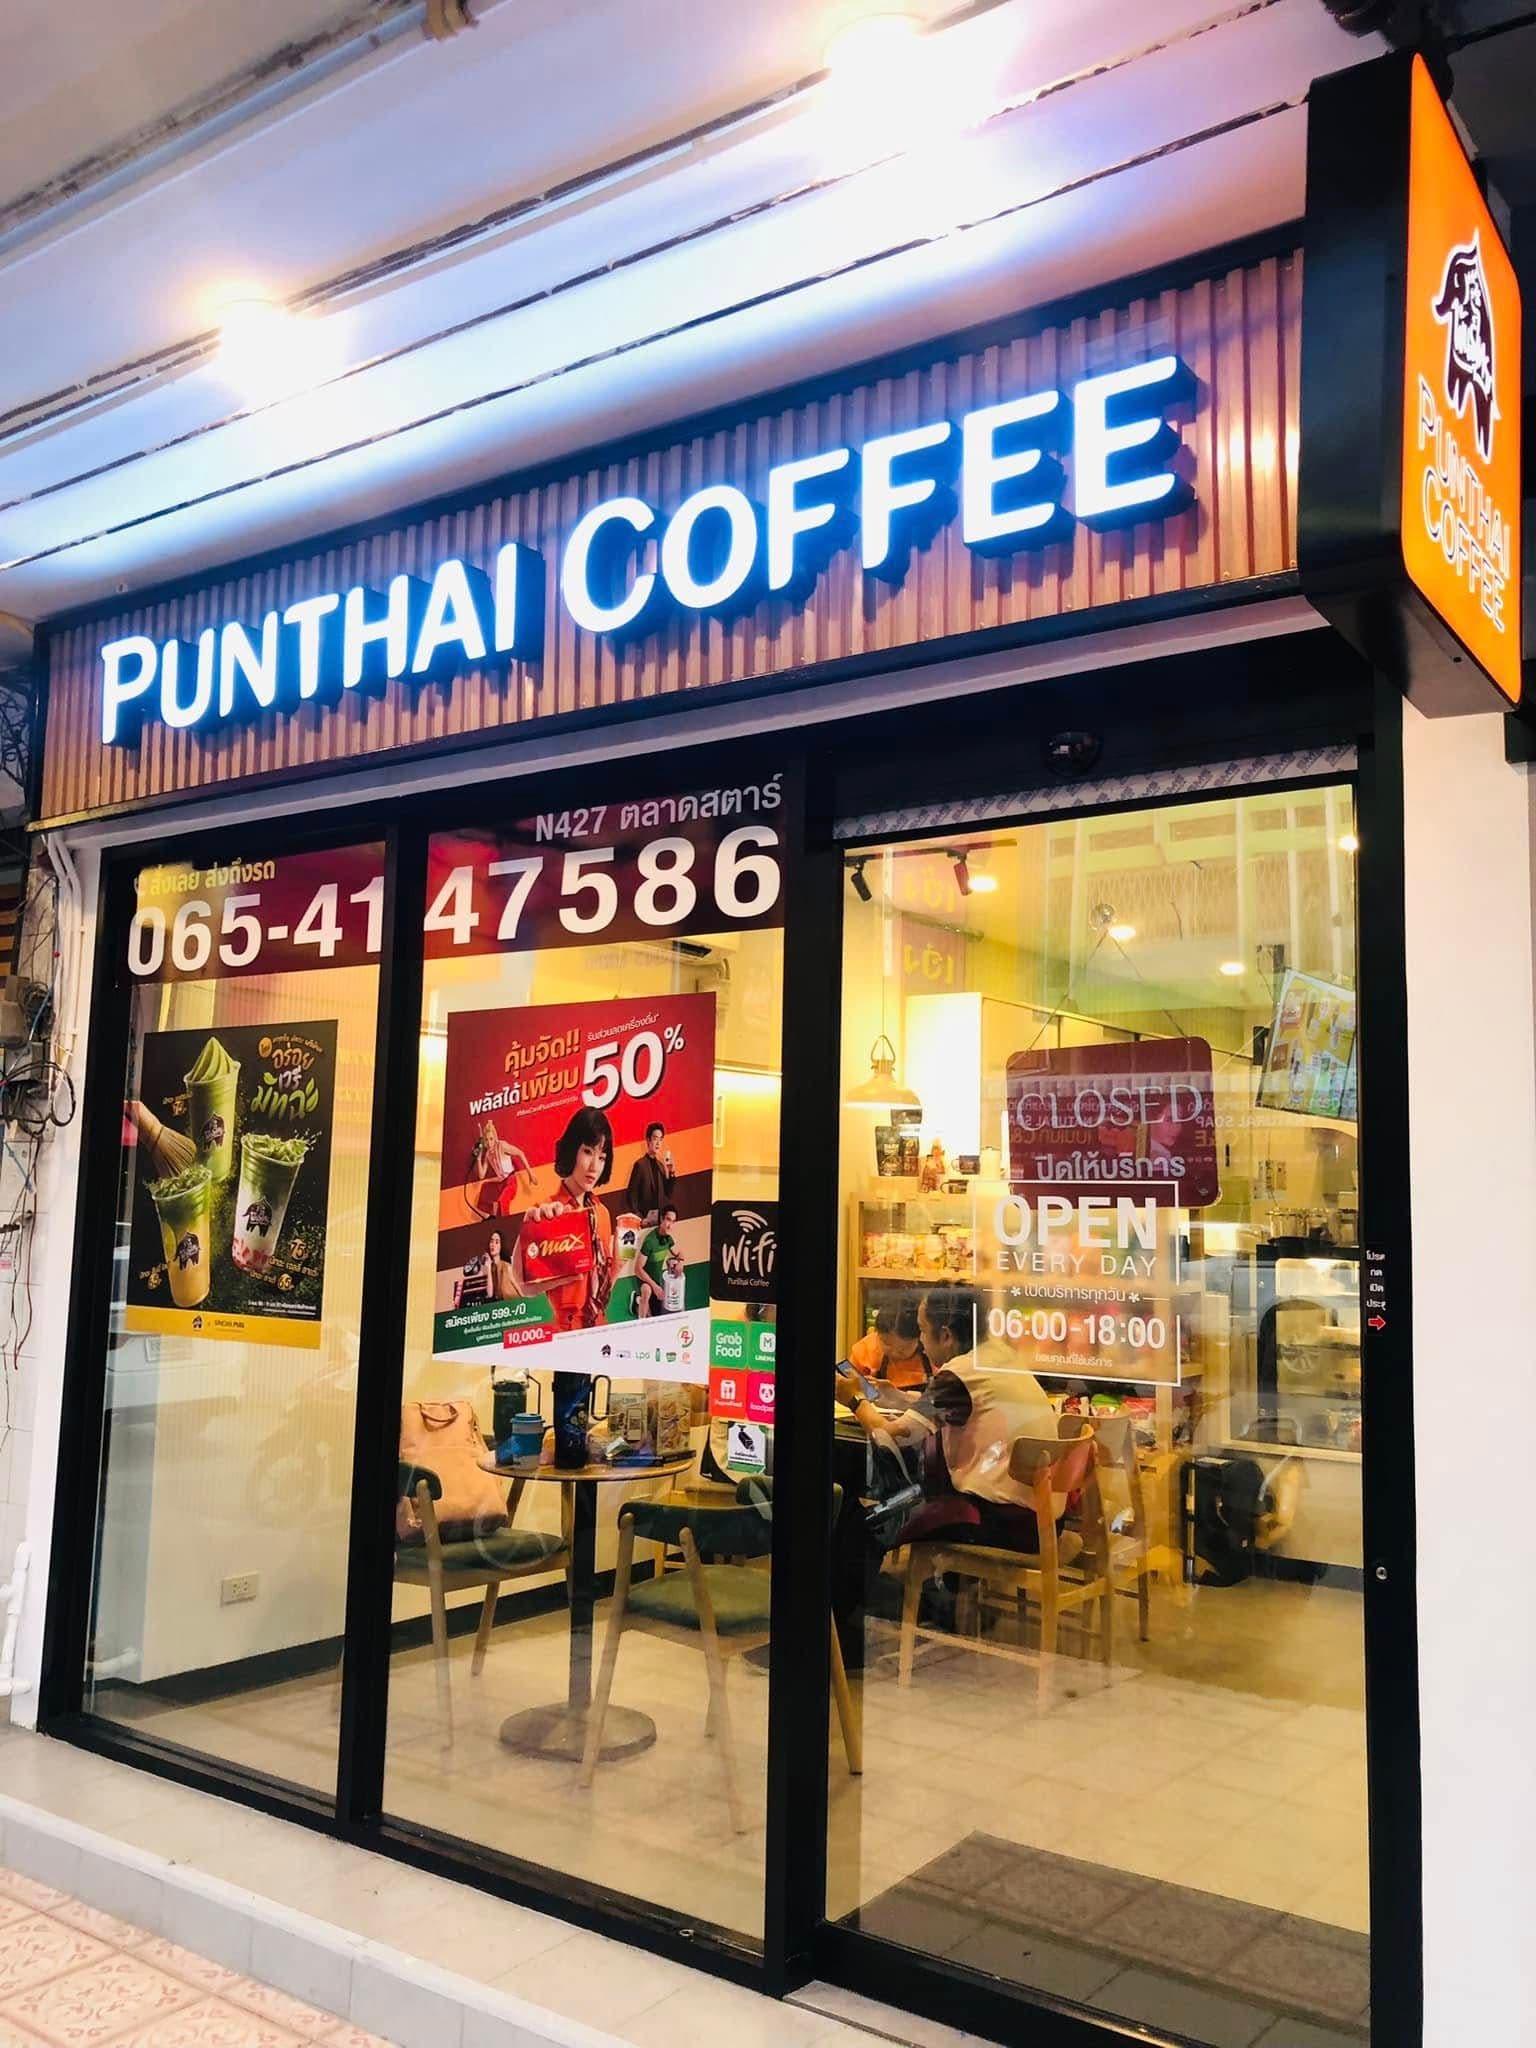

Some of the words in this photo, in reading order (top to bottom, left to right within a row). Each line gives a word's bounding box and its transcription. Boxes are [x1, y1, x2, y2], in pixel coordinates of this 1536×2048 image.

[1418, 373, 1510, 578] PUNTHAI
[101, 542, 518, 745] PUNTHAI
[561, 355, 1178, 633] COFFEE
[1423, 464, 1505, 634] COFFEE
[535, 805, 608, 842] N427
[619, 773, 783, 831] ตลาดสตาร์
[127, 876, 385, 977] 065-41
[423, 825, 781, 945] 47586
[504, 1028, 581, 1079] คุ้มจัด!!
[581, 1024, 685, 1109] 50%
[1016, 1083, 1203, 1132] CLOSED
[1036, 1150, 1186, 1180] ปิดให้บริการ
[993, 1194, 1157, 1250] OPEN
[996, 1250, 1085, 1275] EVERY
[1101, 1255, 1158, 1277] DAY
[715, 1332, 743, 1346] Grab
[715, 1344, 743, 1358] Food
[988, 1308, 1166, 1349] 06:00-18:00
